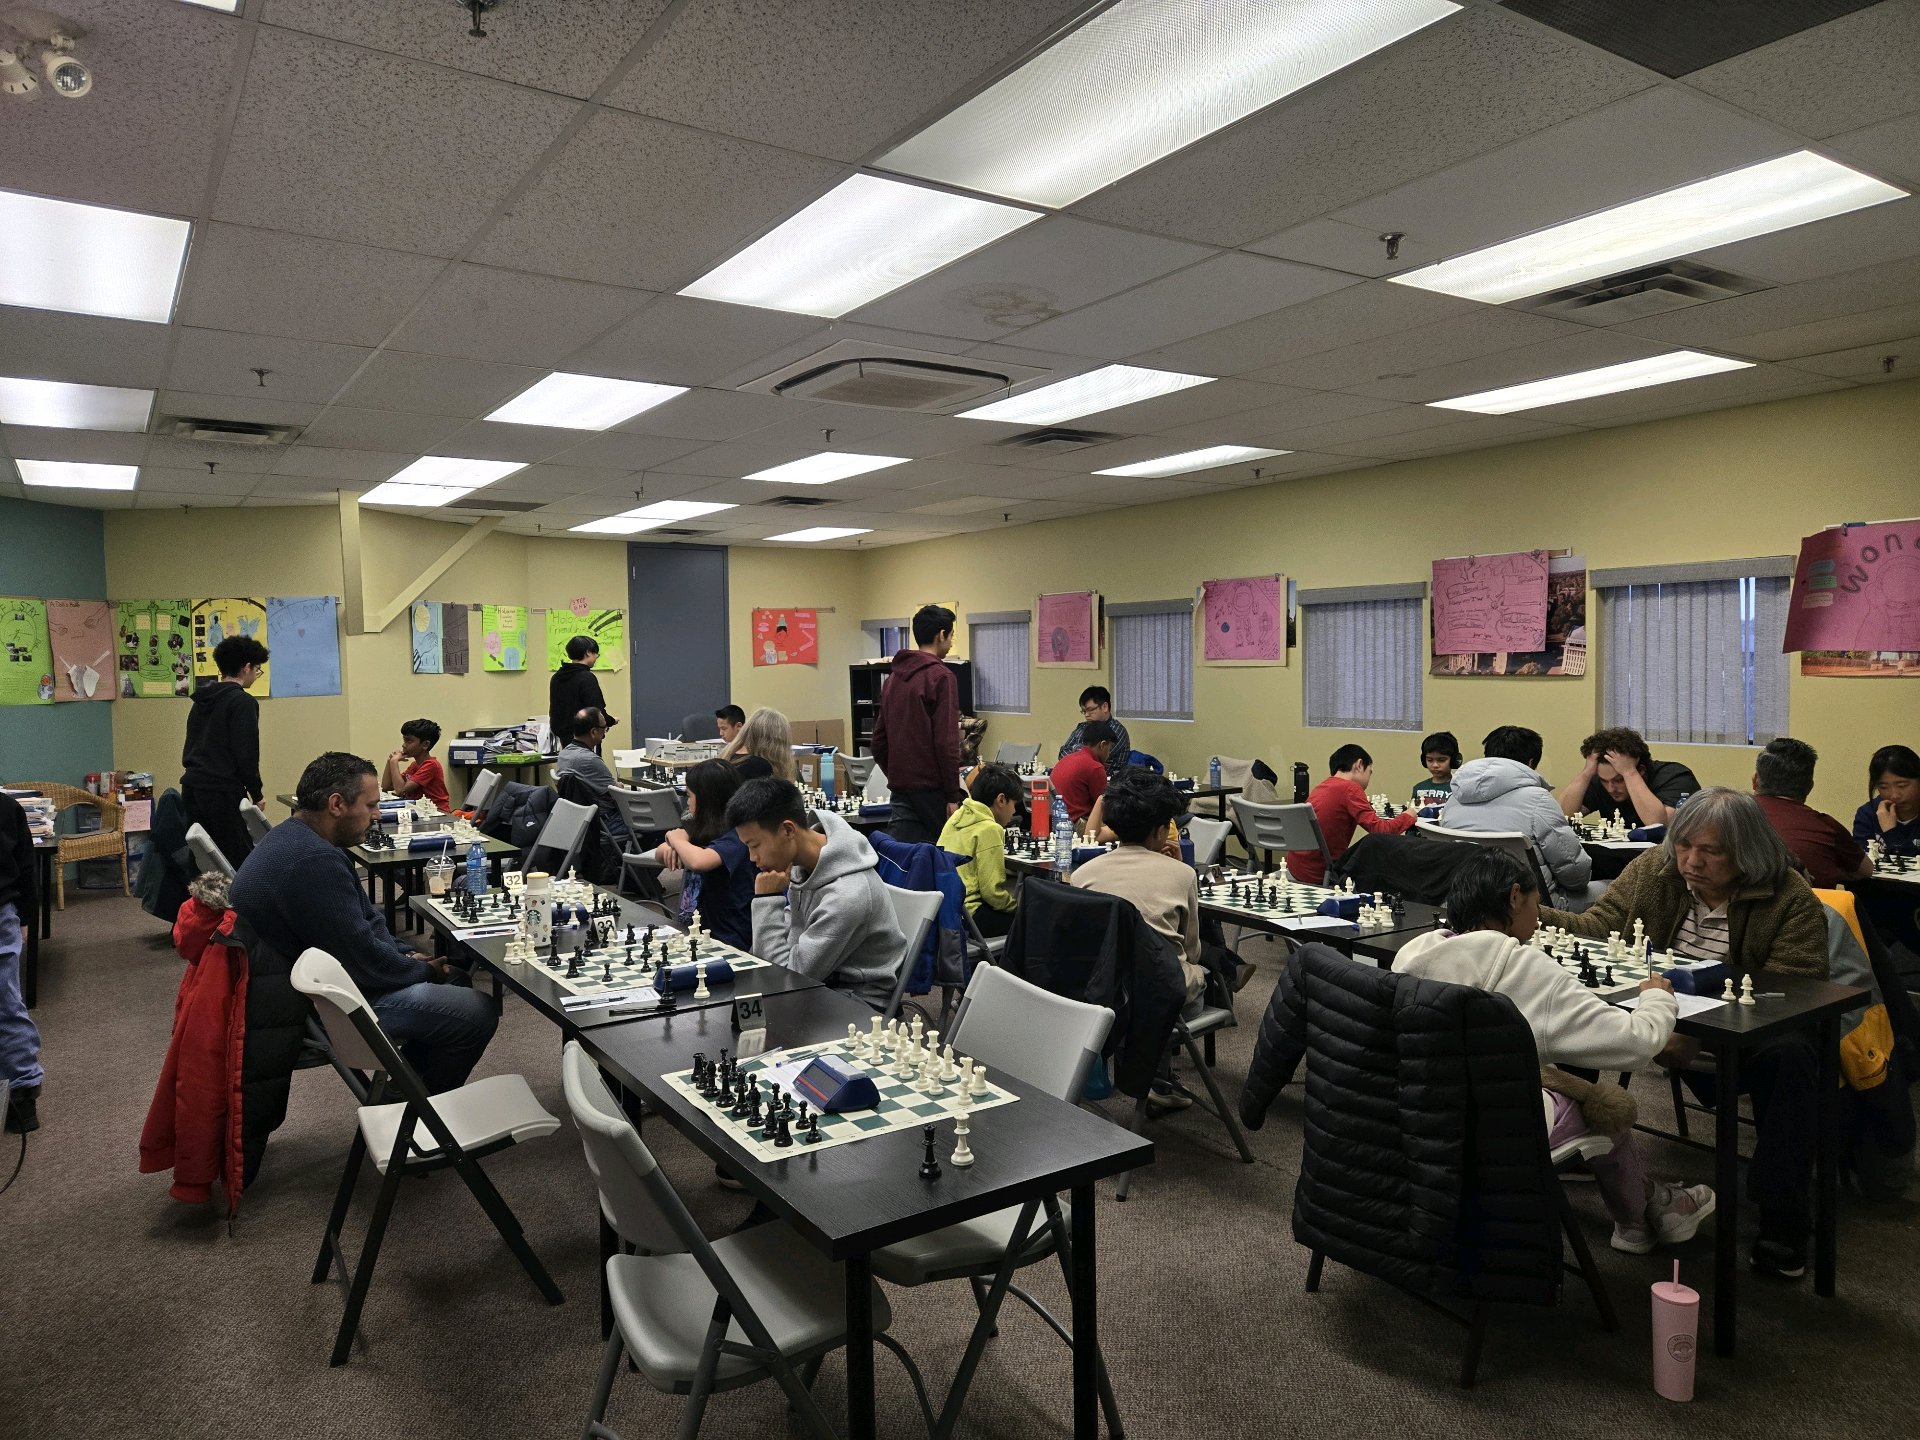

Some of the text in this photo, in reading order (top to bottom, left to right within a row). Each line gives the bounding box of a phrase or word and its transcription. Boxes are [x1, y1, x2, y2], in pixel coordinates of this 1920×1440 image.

[20, 601, 40, 618] STAY
[505, 875, 521, 885] 32
[740, 1000, 762, 1019] 34
